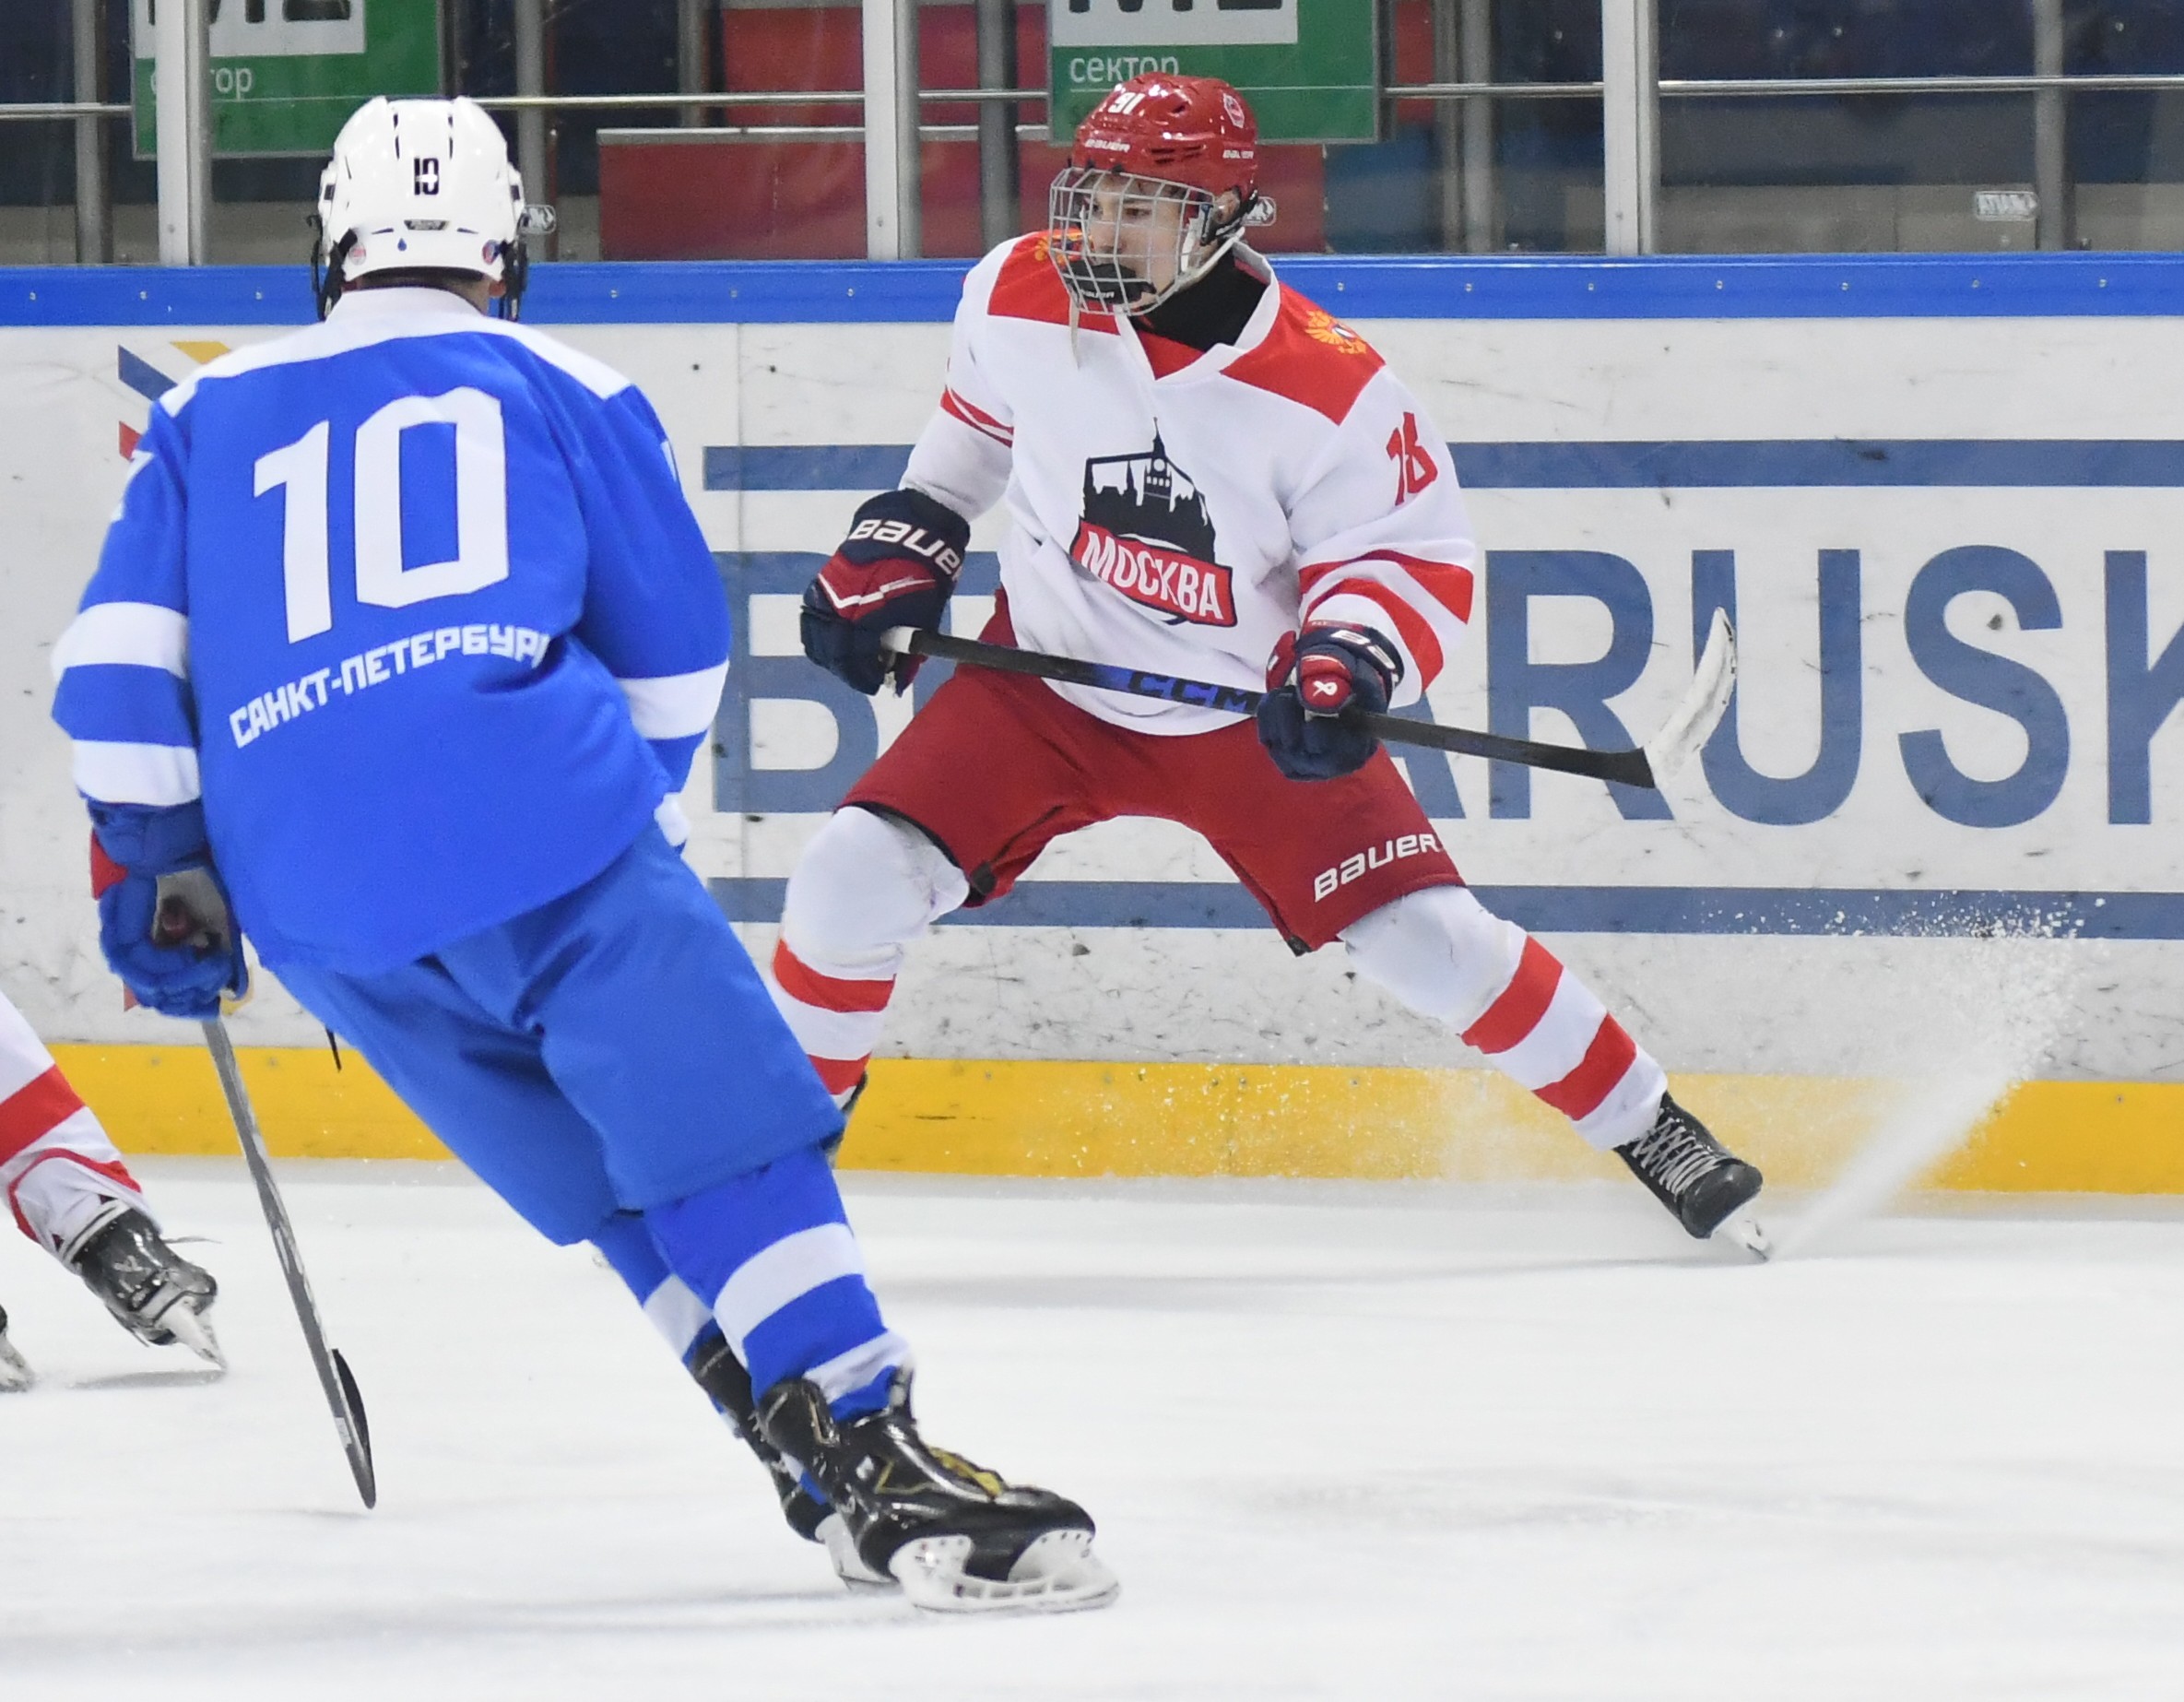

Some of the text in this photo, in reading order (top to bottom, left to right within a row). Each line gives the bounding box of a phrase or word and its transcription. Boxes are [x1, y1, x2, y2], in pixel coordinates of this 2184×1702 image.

[1107, 91, 1146, 115] 91
[413, 157, 440, 195] 10
[254, 384, 510, 644] 10
[1080, 531, 1224, 621] МОСКВА
